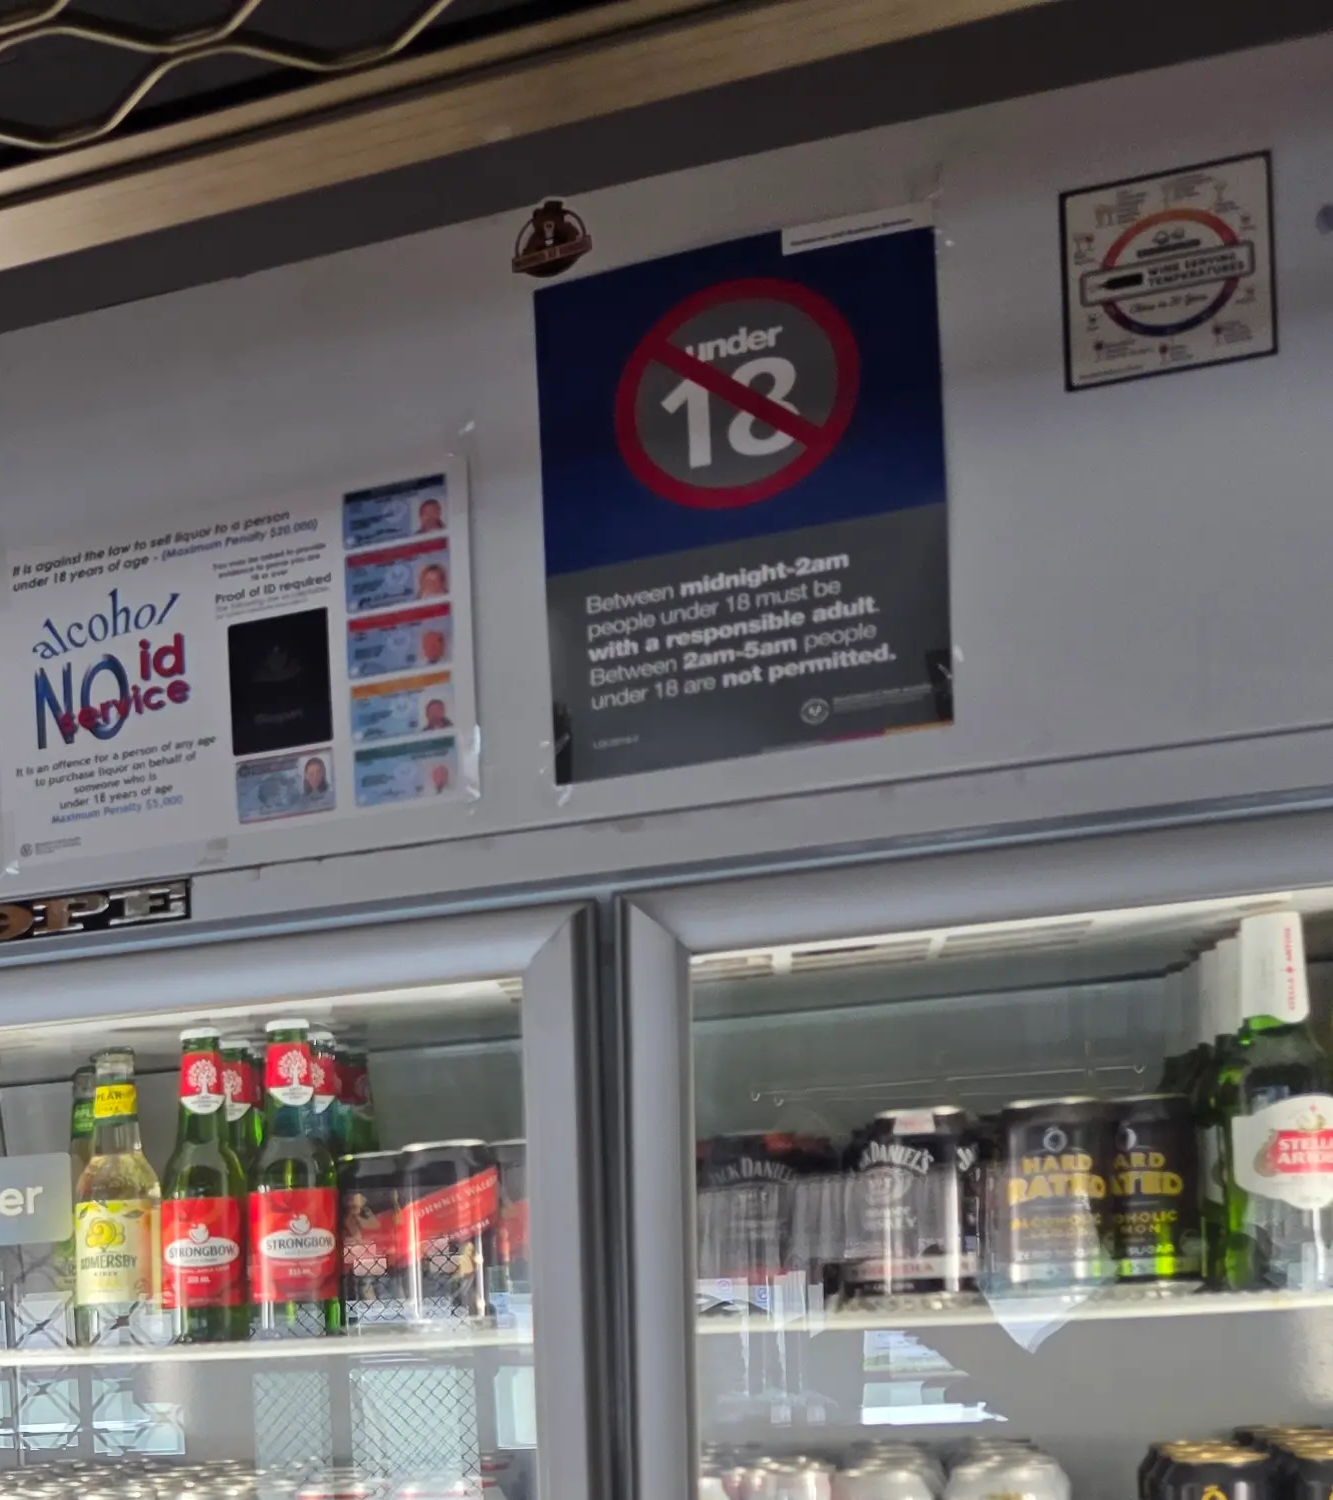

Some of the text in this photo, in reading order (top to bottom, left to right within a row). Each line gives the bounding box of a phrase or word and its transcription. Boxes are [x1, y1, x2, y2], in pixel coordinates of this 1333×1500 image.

[685, 325, 783, 363] under
[661, 357, 801, 469] 18
[34, 510, 290, 573] against the law to sell liquor to person
[12, 553, 150, 593] under 18 years of age
[215, 571, 332, 604] Proof of ID required
[586, 552, 850, 615] Between midnight-2am
[31, 587, 181, 660] alcohol
[587, 578, 842, 642] people under 18 must be
[588, 595, 881, 663] with a responsible adult.
[138, 632, 186, 682] id
[589, 621, 878, 687] Between 2am-5am people
[591, 642, 898, 711] under 18 are not permitted.
[34, 653, 130, 750] NO
[60, 679, 191, 734] service
[48, 750, 197, 789] purchase liquor behalf of
[51, 735, 217, 772] offence for person of any age
[59, 783, 174, 811] under 18 years of age
[73, 774, 145, 795] someone who
[1022, 1153, 1093, 1174] HARD
[1008, 1173, 1107, 1205] RATED
[80, 1253, 138, 1271] SOMERSBY
[167, 1240, 236, 1259] STRONGBOW
[265, 1234, 334, 1252] STRONGBOW
